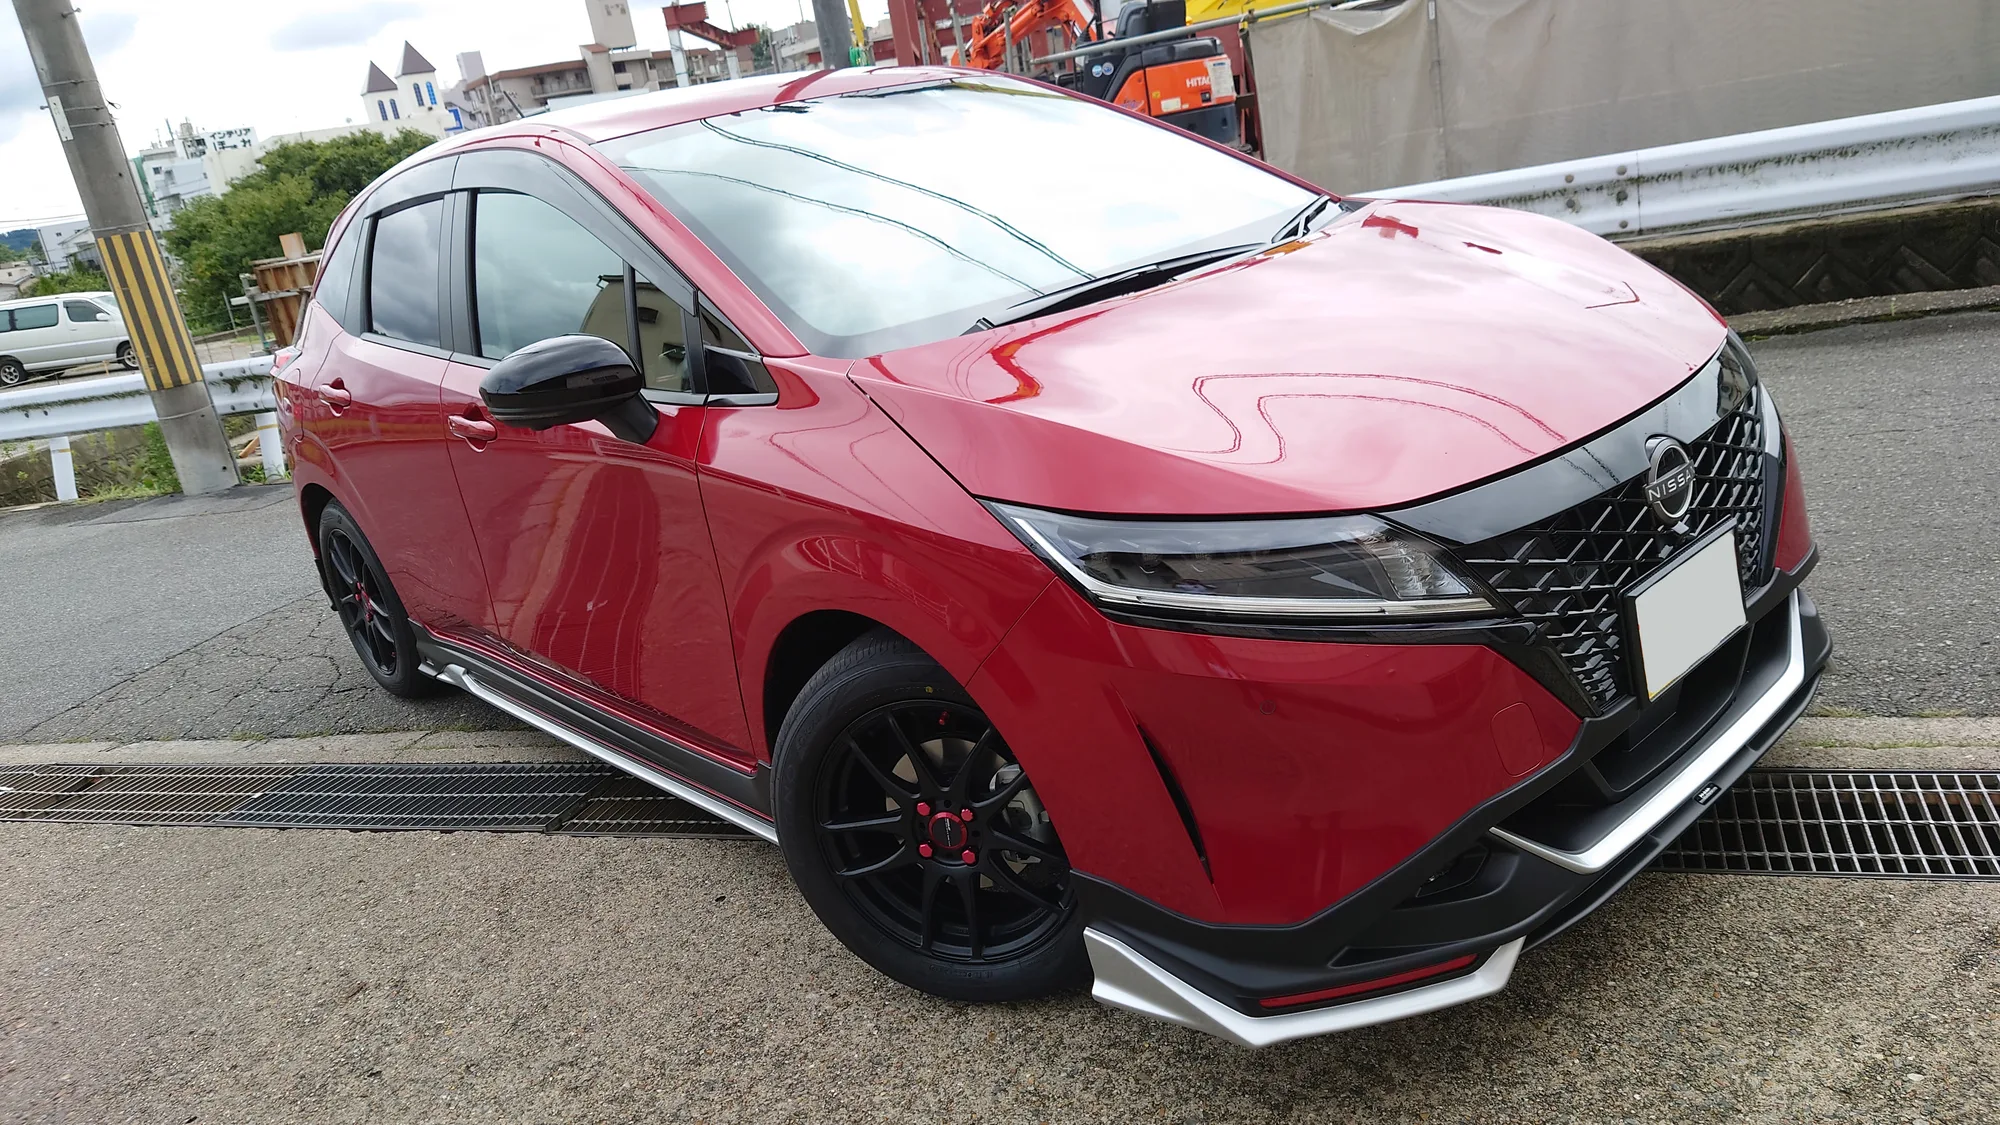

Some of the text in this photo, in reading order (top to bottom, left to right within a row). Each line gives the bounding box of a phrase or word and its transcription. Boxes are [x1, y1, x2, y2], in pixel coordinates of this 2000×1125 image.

[210, 128, 251, 140] インテリア
